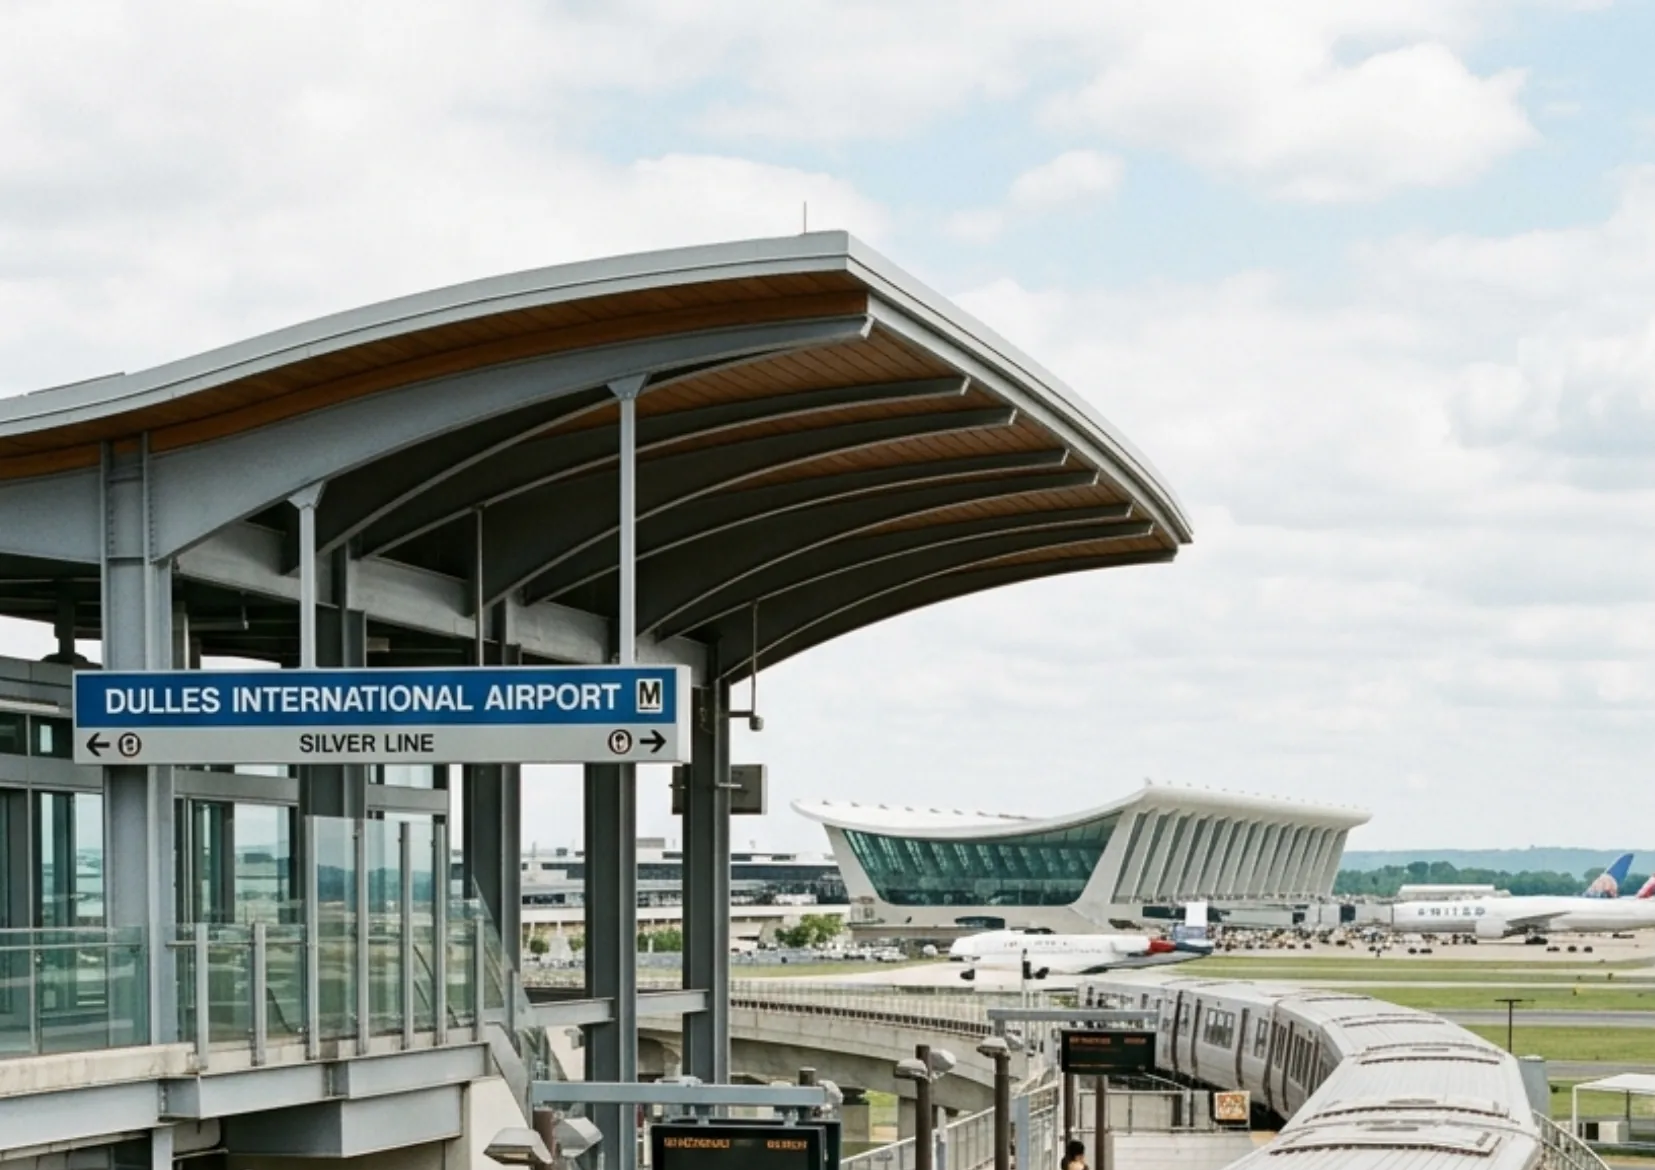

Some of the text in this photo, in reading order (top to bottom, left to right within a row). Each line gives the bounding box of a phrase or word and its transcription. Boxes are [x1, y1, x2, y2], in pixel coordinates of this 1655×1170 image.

[105, 683, 622, 714] DULLES INTERNATIONAL AIRPORT
[639, 681, 661, 705] M
[299, 733, 434, 753] SILVER LINE
